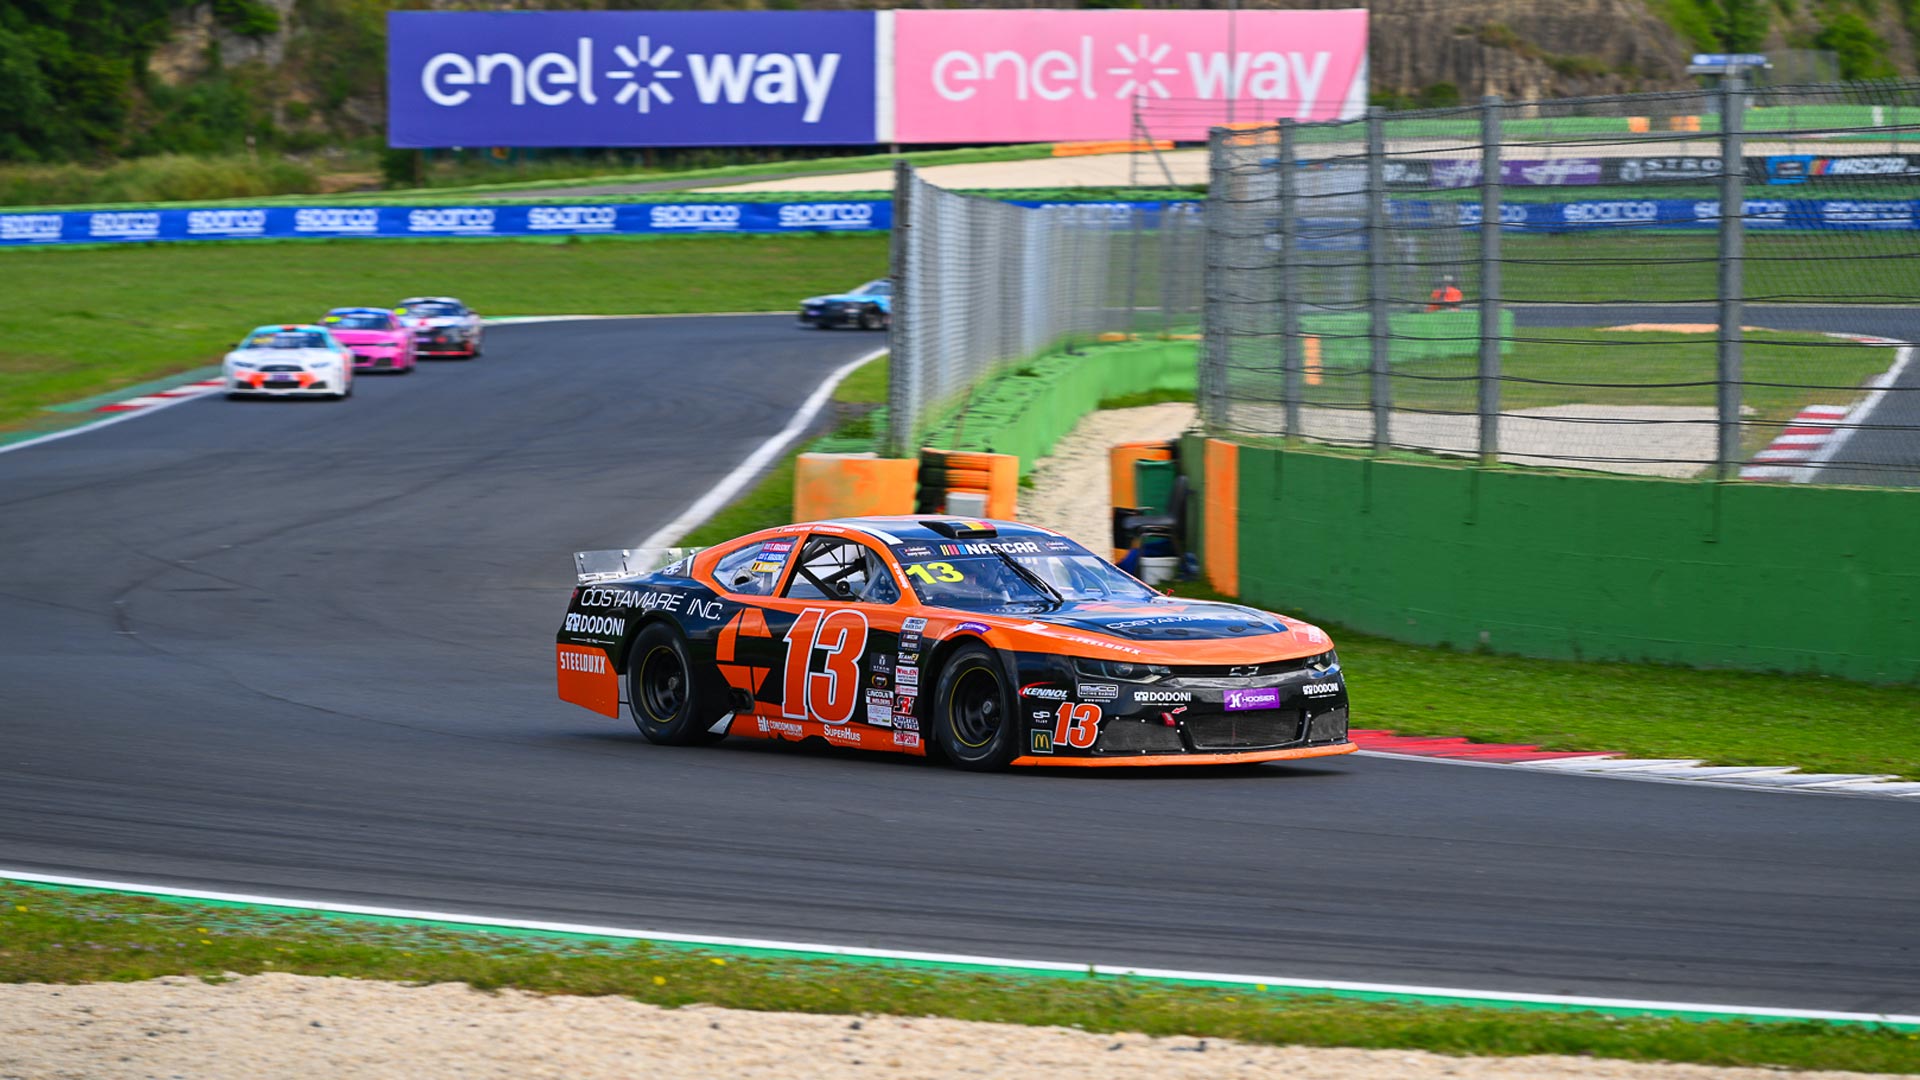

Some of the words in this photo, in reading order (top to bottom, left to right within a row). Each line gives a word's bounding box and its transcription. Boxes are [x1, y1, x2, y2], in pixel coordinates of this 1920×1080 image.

[421, 38, 596, 107] enel
[688, 53, 842, 124] way
[932, 36, 1094, 102] enel
[1187, 50, 1331, 118] way
[188, 210, 266, 228] sparco
[295, 208, 378, 226] sparco
[409, 207, 496, 226] sparco
[528, 206, 617, 224] sparco
[651, 205, 741, 223] sparco
[780, 203, 873, 222] sparco
[1563, 201, 1658, 219] sparco
[90, 213, 160, 230] sparco
[905, 562, 965, 584] 13
[581, 588, 685, 612] COSTAMARE
[688, 598, 724, 620] INC.
[580, 615, 625, 637] DODONI
[560, 652, 606, 675] STEELDUXX
[783, 608, 868, 725] 13
[1022, 686, 1068, 698] KENNOL
[1150, 691, 1192, 702] DODONI
[1314, 683, 1339, 694] DODONI
[1053, 701, 1102, 748] 13
[896, 732, 917, 744] SIMPSON
